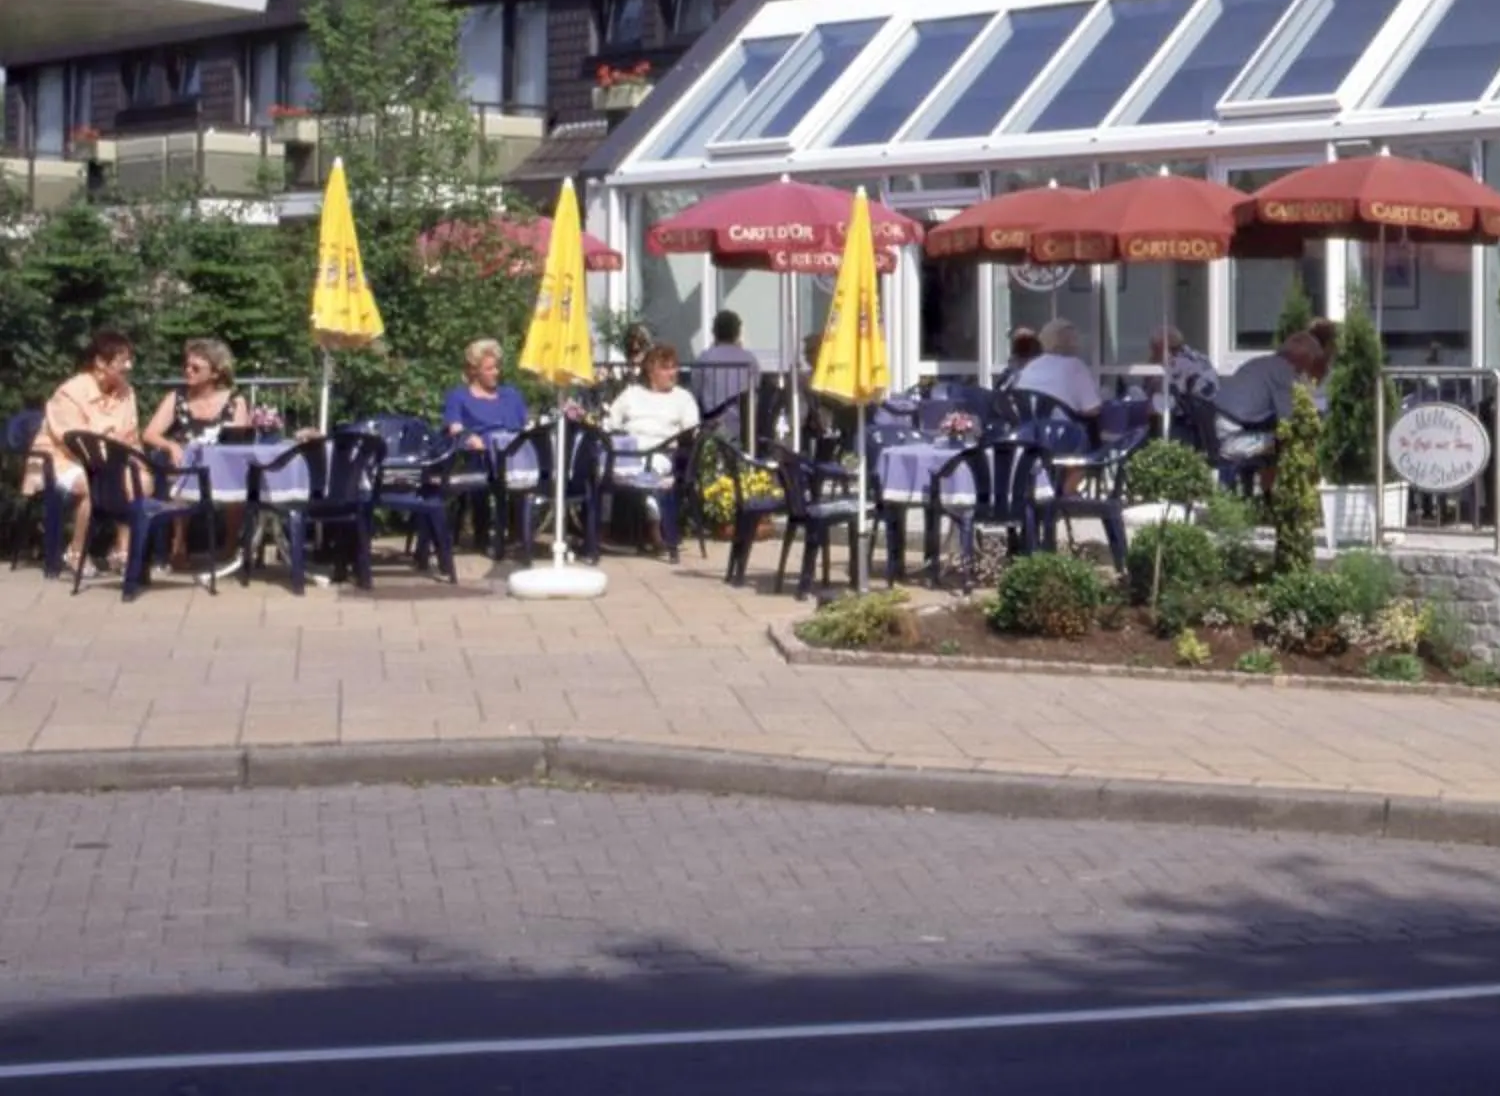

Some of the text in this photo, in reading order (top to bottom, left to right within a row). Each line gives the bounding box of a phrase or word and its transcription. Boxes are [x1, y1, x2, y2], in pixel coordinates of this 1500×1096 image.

[1371, 201, 1461, 226] CARTE D'OR
[728, 223, 774, 241] CARTE
[776, 222, 814, 241] D'OR
